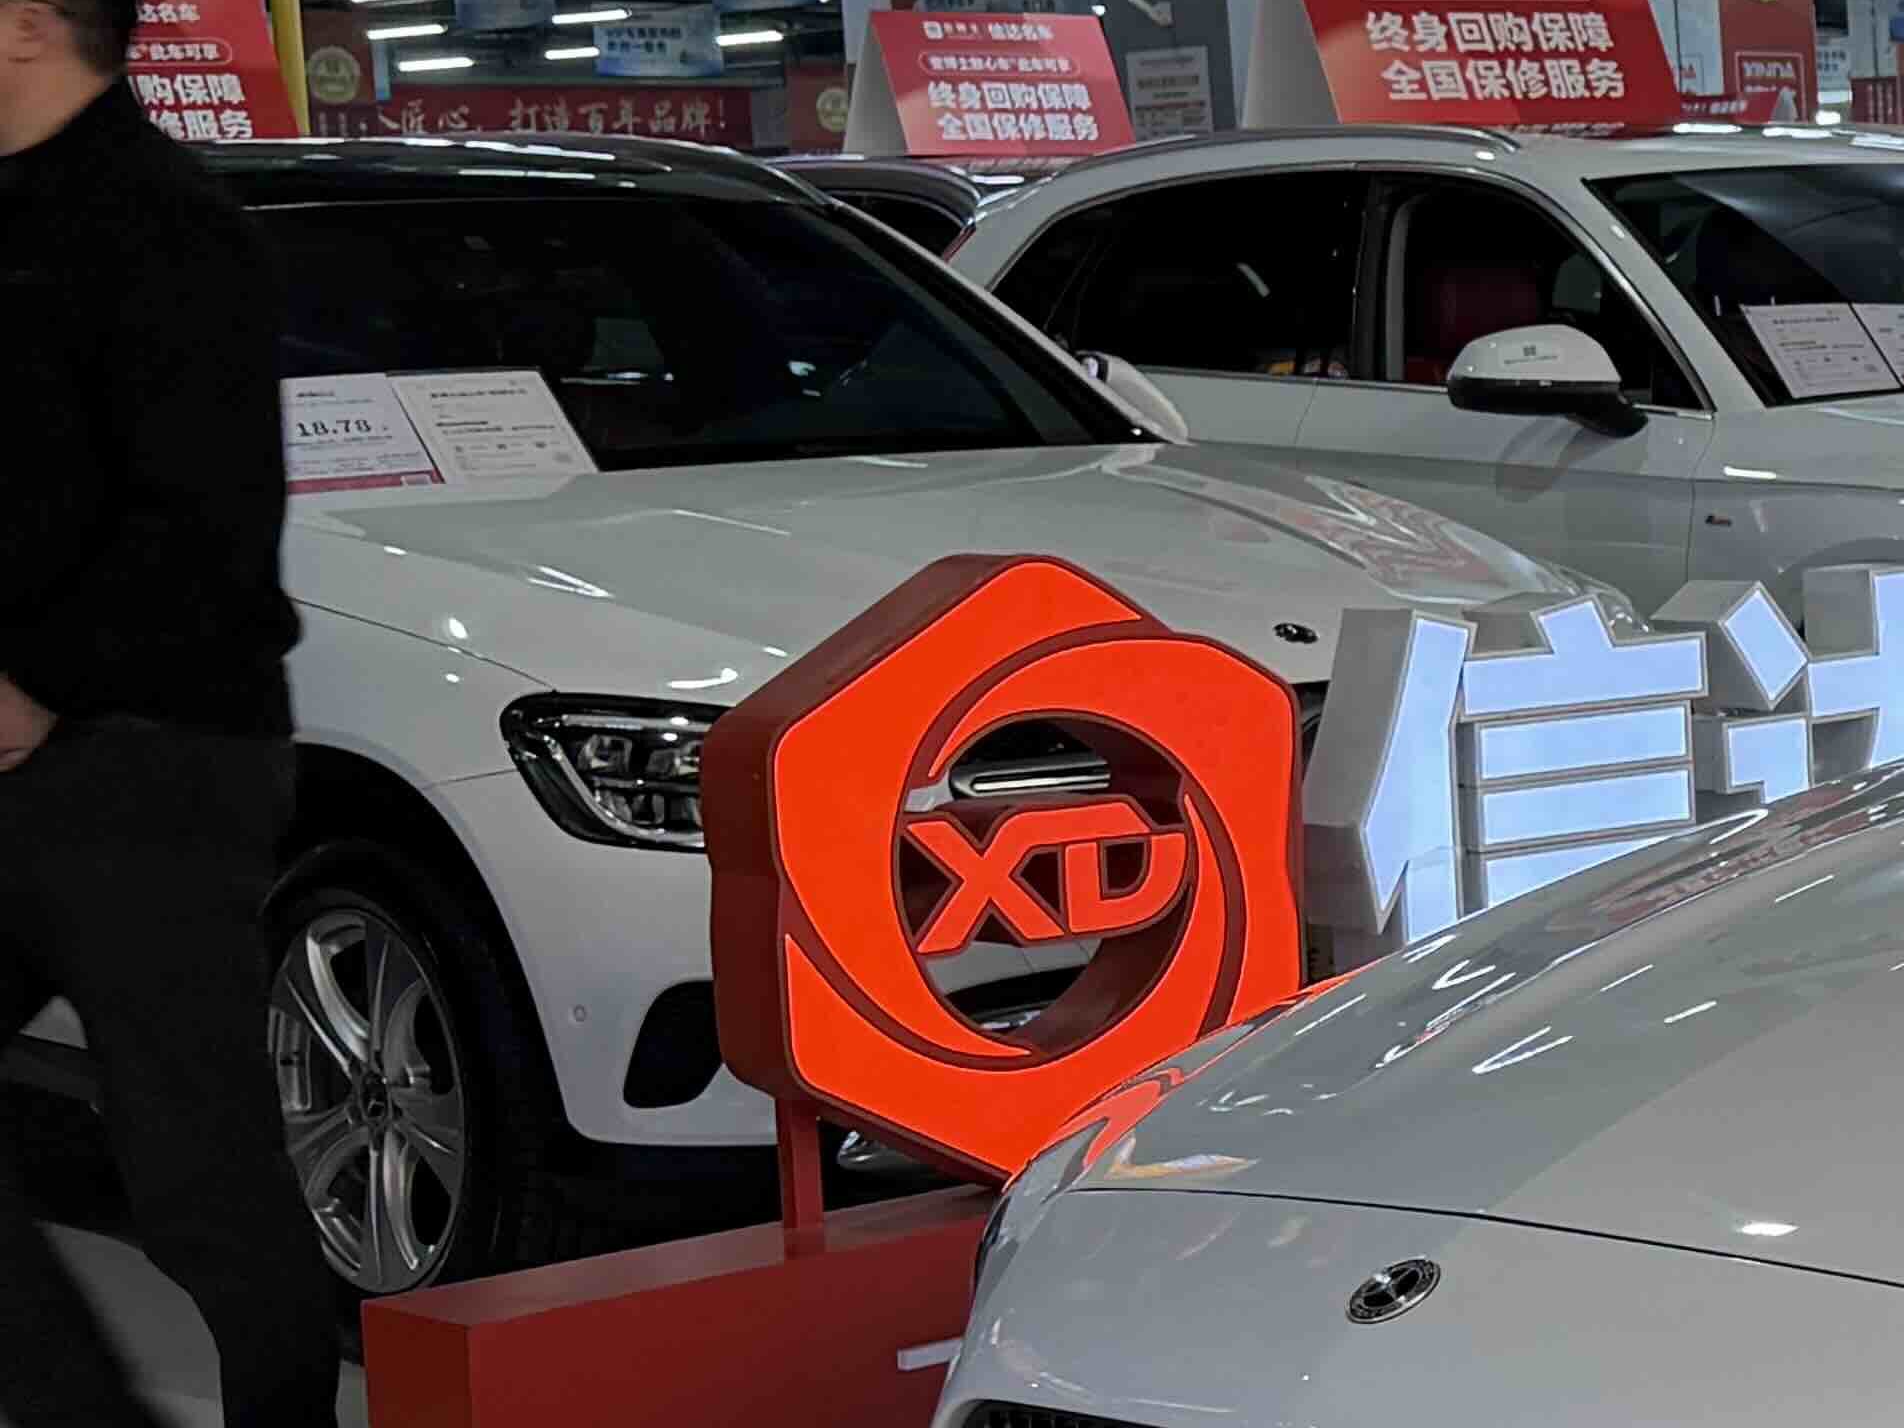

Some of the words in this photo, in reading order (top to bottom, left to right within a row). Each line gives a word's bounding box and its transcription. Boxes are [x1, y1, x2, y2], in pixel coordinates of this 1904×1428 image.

[1366, 12, 1615, 52] 终身回购保障
[927, 81, 1092, 110] 终身回购保障
[1382, 58, 1625, 101] 全国保修服务
[937, 112, 1099, 141] 全国保修服务
[905, 799, 1187, 955] XD
